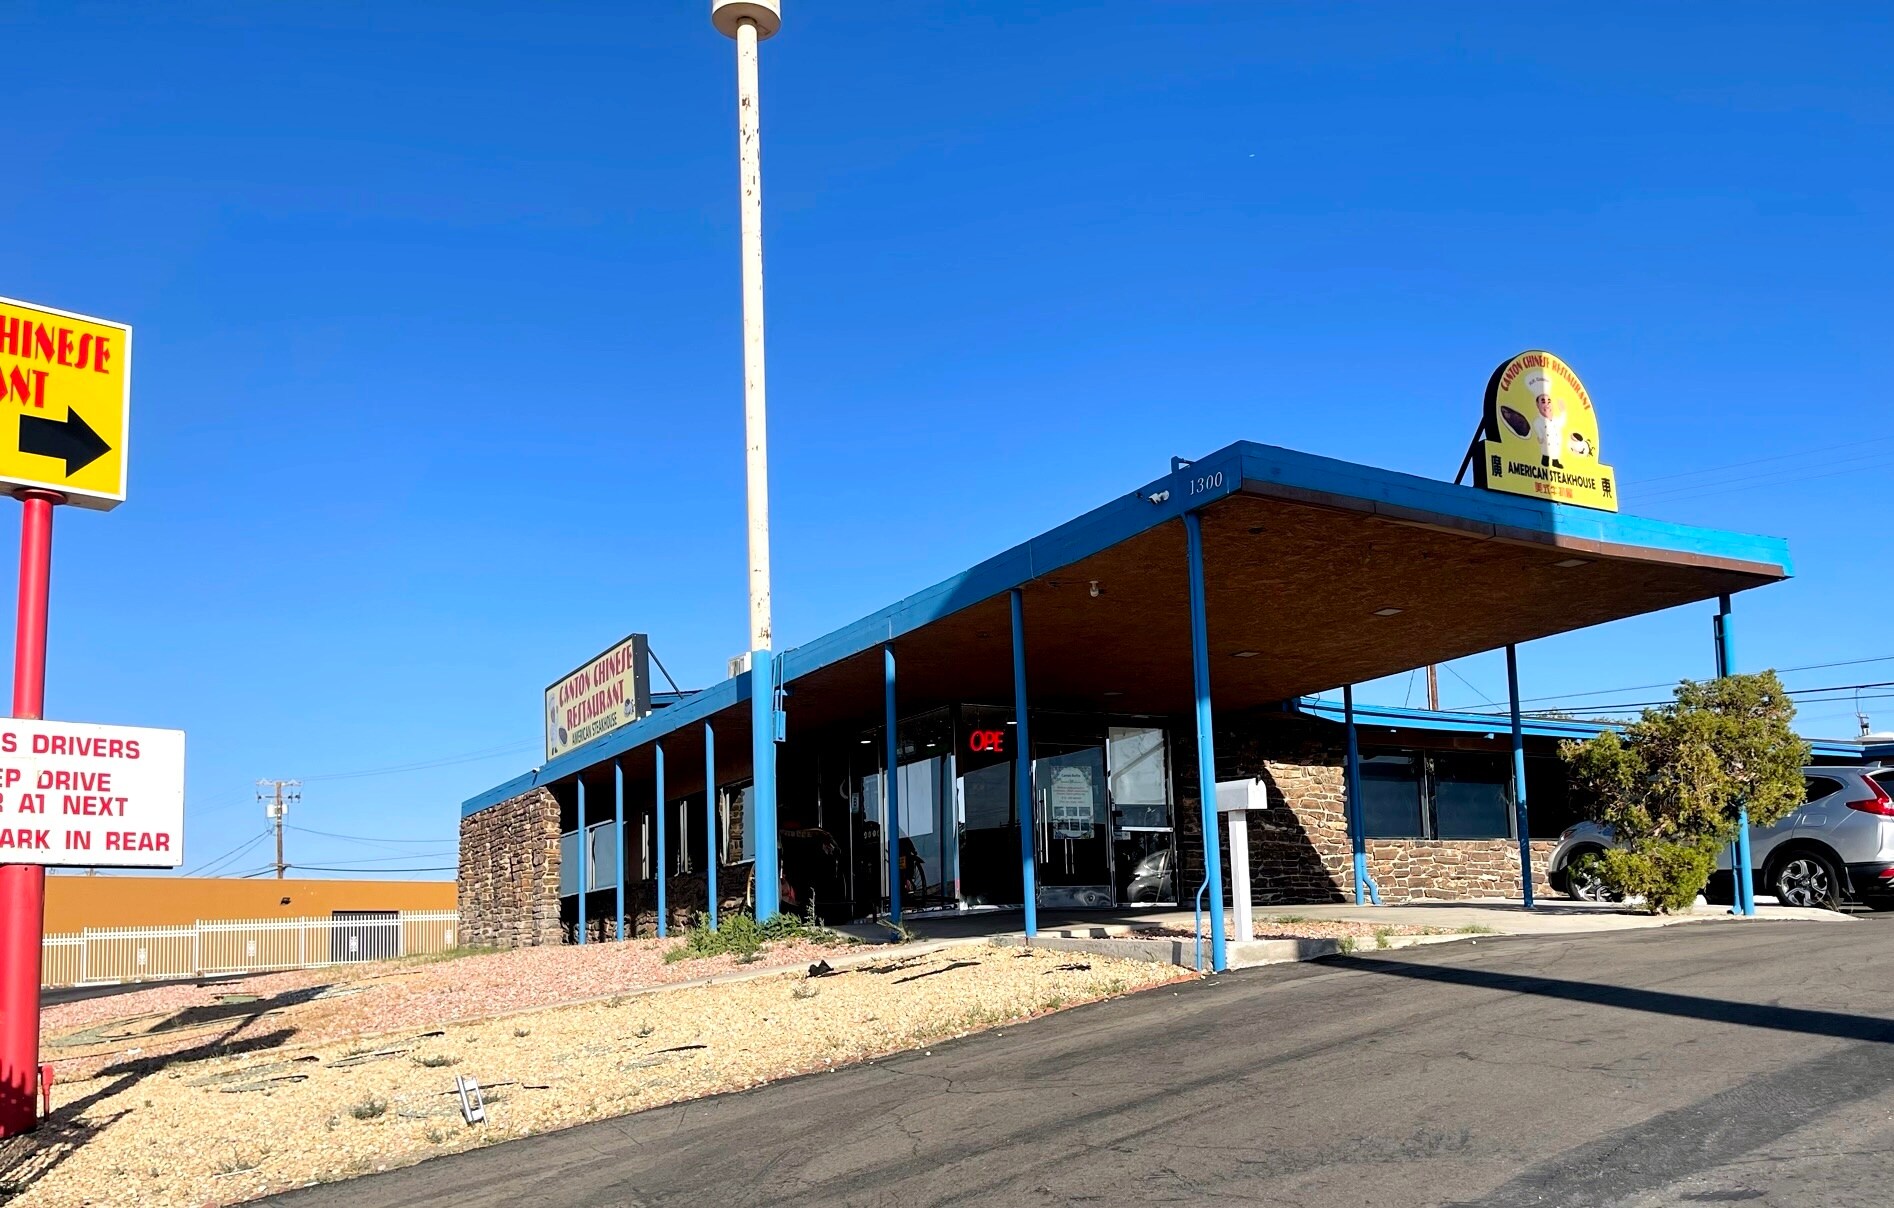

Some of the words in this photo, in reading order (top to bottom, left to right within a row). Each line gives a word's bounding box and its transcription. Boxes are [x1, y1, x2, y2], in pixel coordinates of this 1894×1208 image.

[1501, 363, 1524, 392] CANTON
[1522, 355, 1550, 369] CHINESE
[1551, 360, 1592, 411] RESTAURANT
[1190, 471, 1223, 496] 1300
[1508, 461, 1548, 481] AMERICAN
[1549, 470, 1596, 490] STEAKHOUSE
[559, 669, 591, 708] CANTON
[593, 644, 633, 688] CHINESE
[566, 679, 625, 731] RESTAURANT
[572, 722, 592, 744] AMERICAN
[592, 711, 617, 735] STEAKHOUSE
[32, 734, 140, 760] DRIVERS
[0, 768, 21, 788] P
[36, 770, 111, 792] DRIVE
[63, 795, 129, 817] NEXT
[65, 830, 91, 850] IN
[105, 831, 170, 852] REAR
